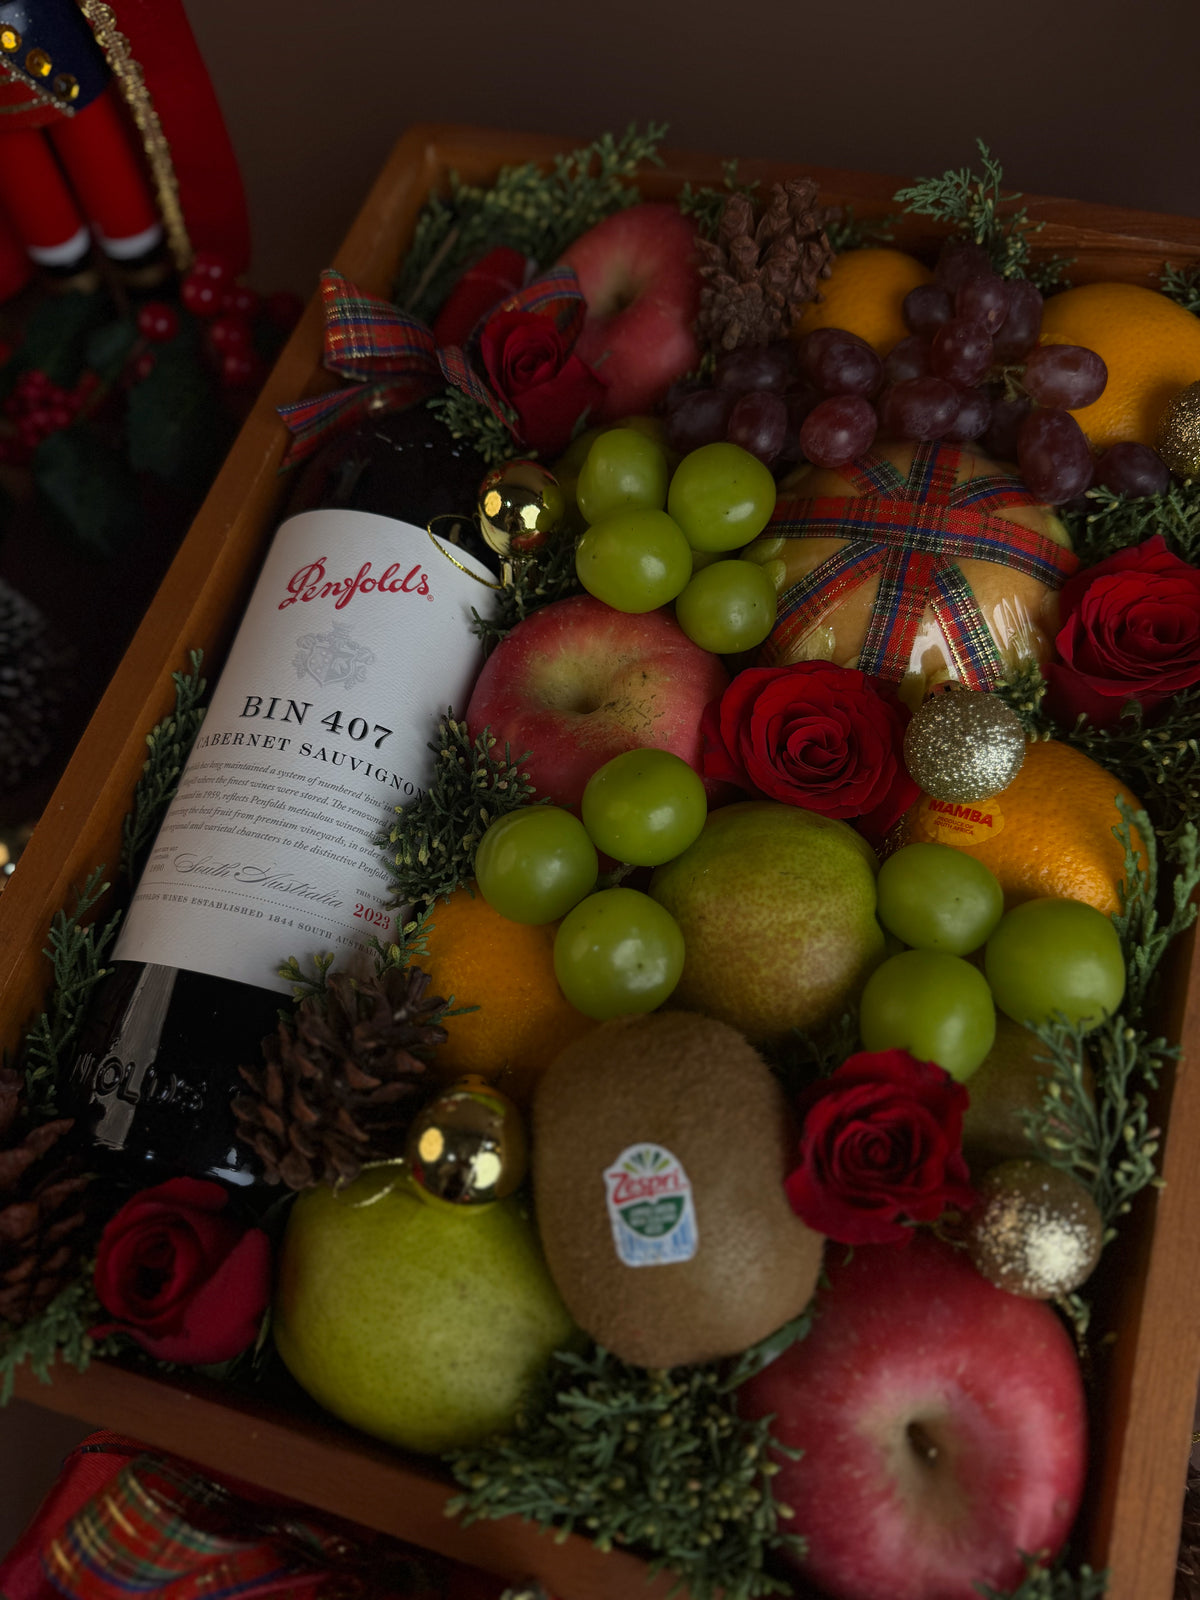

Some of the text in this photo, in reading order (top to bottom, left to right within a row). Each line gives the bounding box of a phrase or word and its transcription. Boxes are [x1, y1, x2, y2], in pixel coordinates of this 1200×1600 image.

[278, 556, 430, 610] Penfolds
[239, 695, 394, 749] BIN 407
[197, 732, 426, 803] CABERNET SAUVIGNON
[224, 761, 270, 774] maintained
[277, 769, 306, 783] system
[307, 777, 319, 786] of
[318, 779, 363, 800] numbered
[215, 774, 227, 784] the
[224, 776, 249, 787] finest
[250, 780, 276, 791] wines
[276, 785, 299, 796] were
[300, 790, 329, 806] stored.
[331, 798, 347, 811] The
[348, 806, 388, 828] renowned
[222, 792, 249, 804] reflects
[250, 795, 287, 811] Penfolds
[287, 805, 335, 825] meticulous
[928, 798, 993, 828] MAMBA
[204, 823, 237, 834] varietal
[236, 826, 281, 844] characters
[282, 838, 292, 846] to
[294, 839, 309, 851] the
[309, 843, 357, 867] distinctive
[358, 860, 390, 881] Penfolds
[210, 806, 233, 818] fruit
[231, 810, 254, 821] from
[253, 814, 297, 831] premium
[299, 825, 346, 848] vineyards,
[349, 841, 359, 850] in
[359, 844, 385, 860] order
[174, 852, 343, 909] South Australia
[162, 893, 188, 904] WINES
[191, 897, 264, 919] ESTABLISHED
[268, 914, 294, 928] 1844
[297, 922, 333, 940] SOUTH
[353, 902, 391, 930] 2023
[608, 1168, 680, 1206] Zespri
